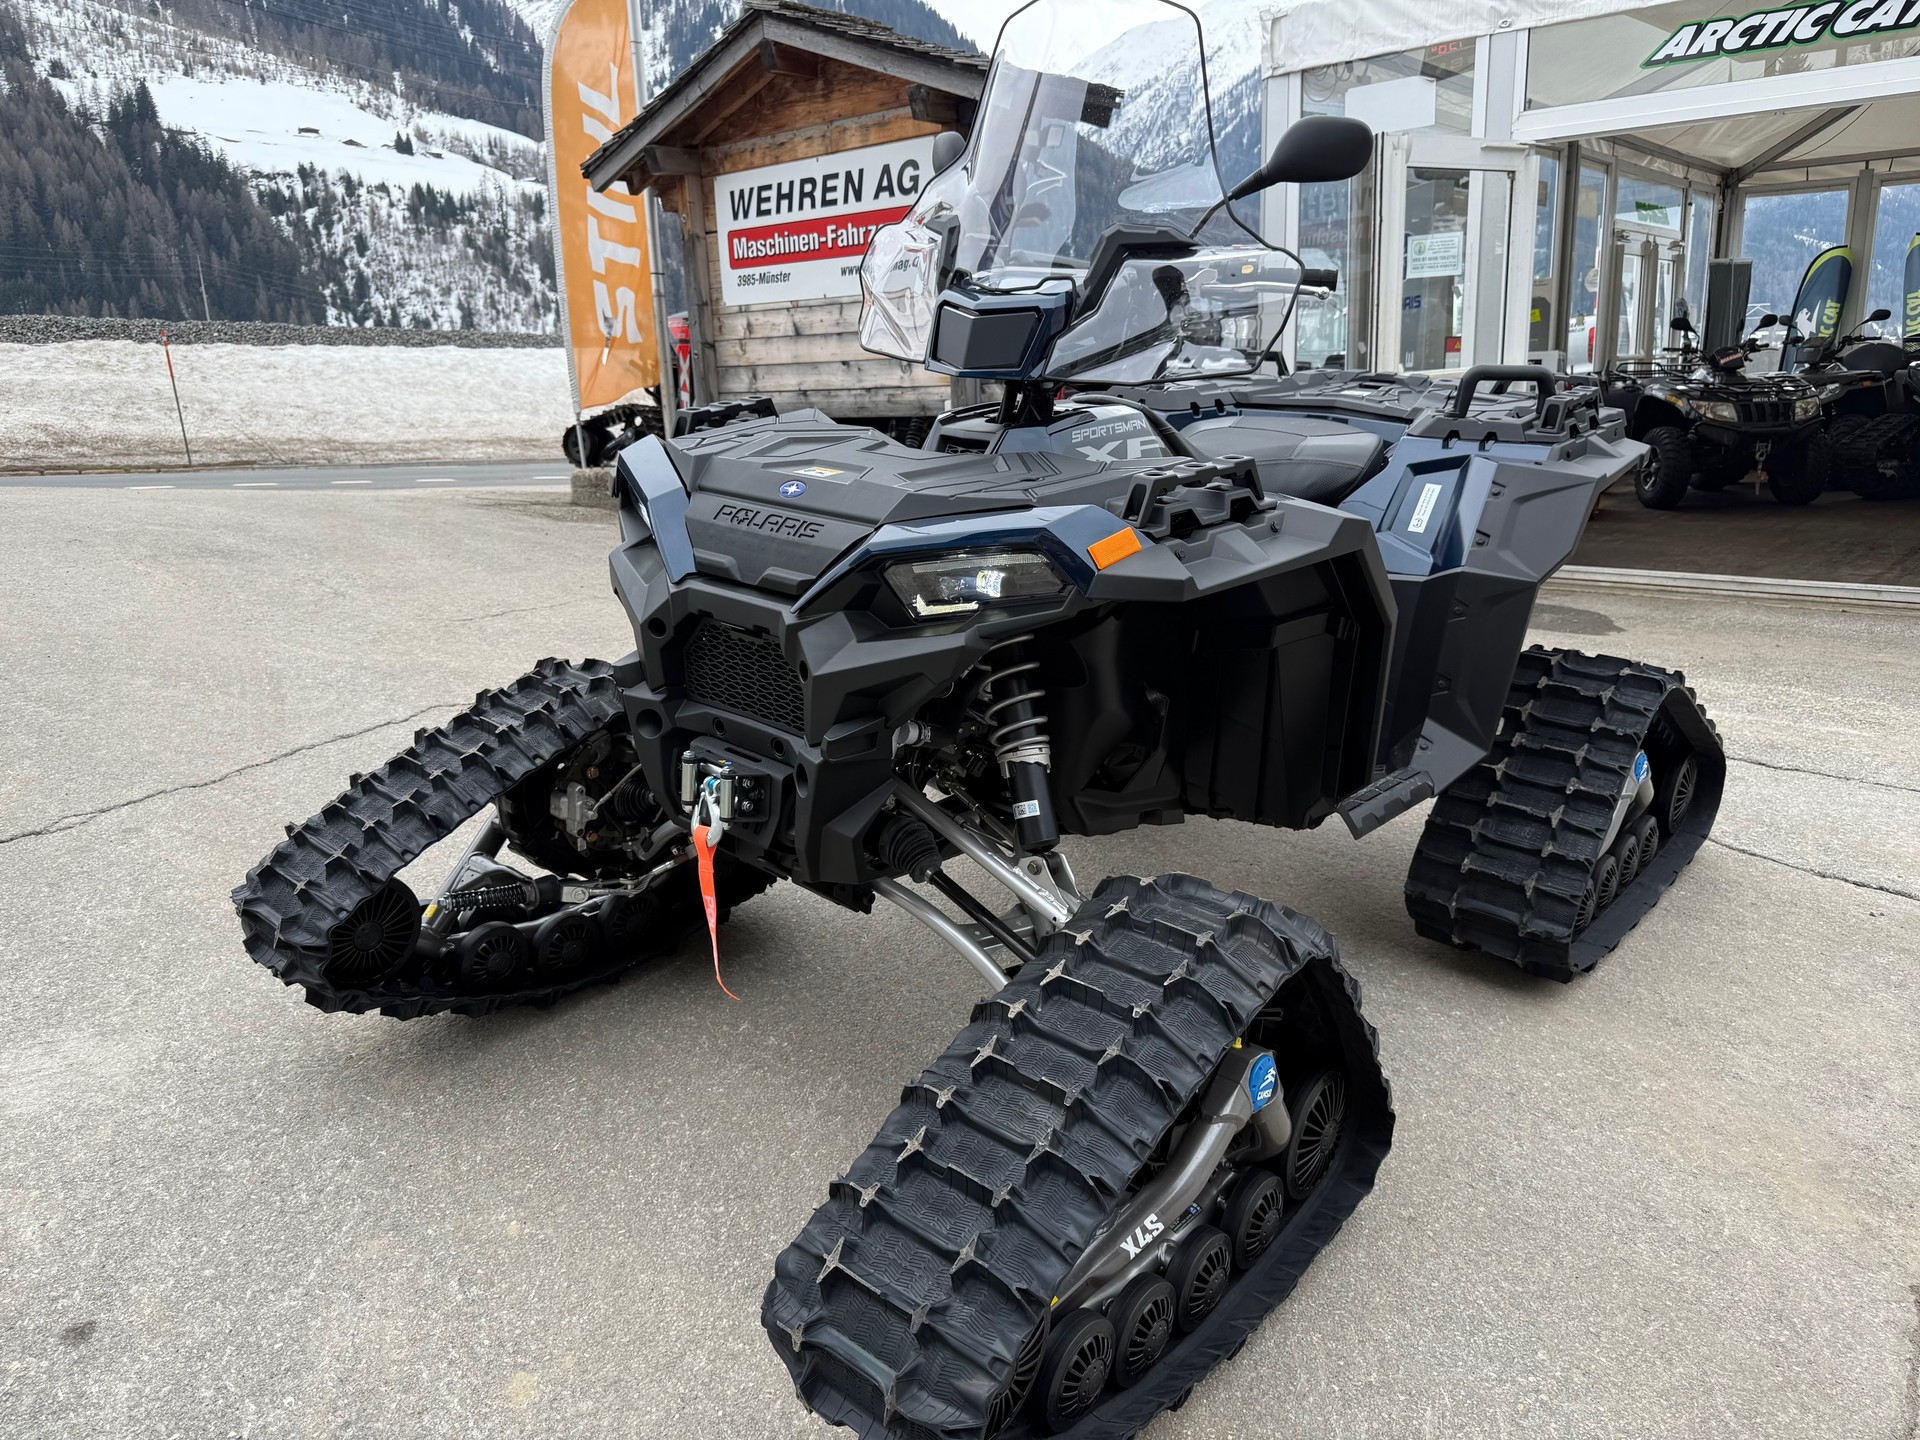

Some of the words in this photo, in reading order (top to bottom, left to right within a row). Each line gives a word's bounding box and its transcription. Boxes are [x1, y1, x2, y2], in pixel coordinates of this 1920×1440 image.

[1650, 2, 1841, 62] ARCTIC
[730, 168, 864, 221] WEHREN
[873, 159, 920, 200] AG
[732, 223, 884, 260] Maschinen-Fahrz
[737, 271, 791, 287] 3985-Münster
[1823, 298, 1840, 325] CAT
[1071, 419, 1147, 443] SPORTSMAN
[713, 504, 825, 538] POLARIS
[1119, 1212, 1165, 1260] X4S
